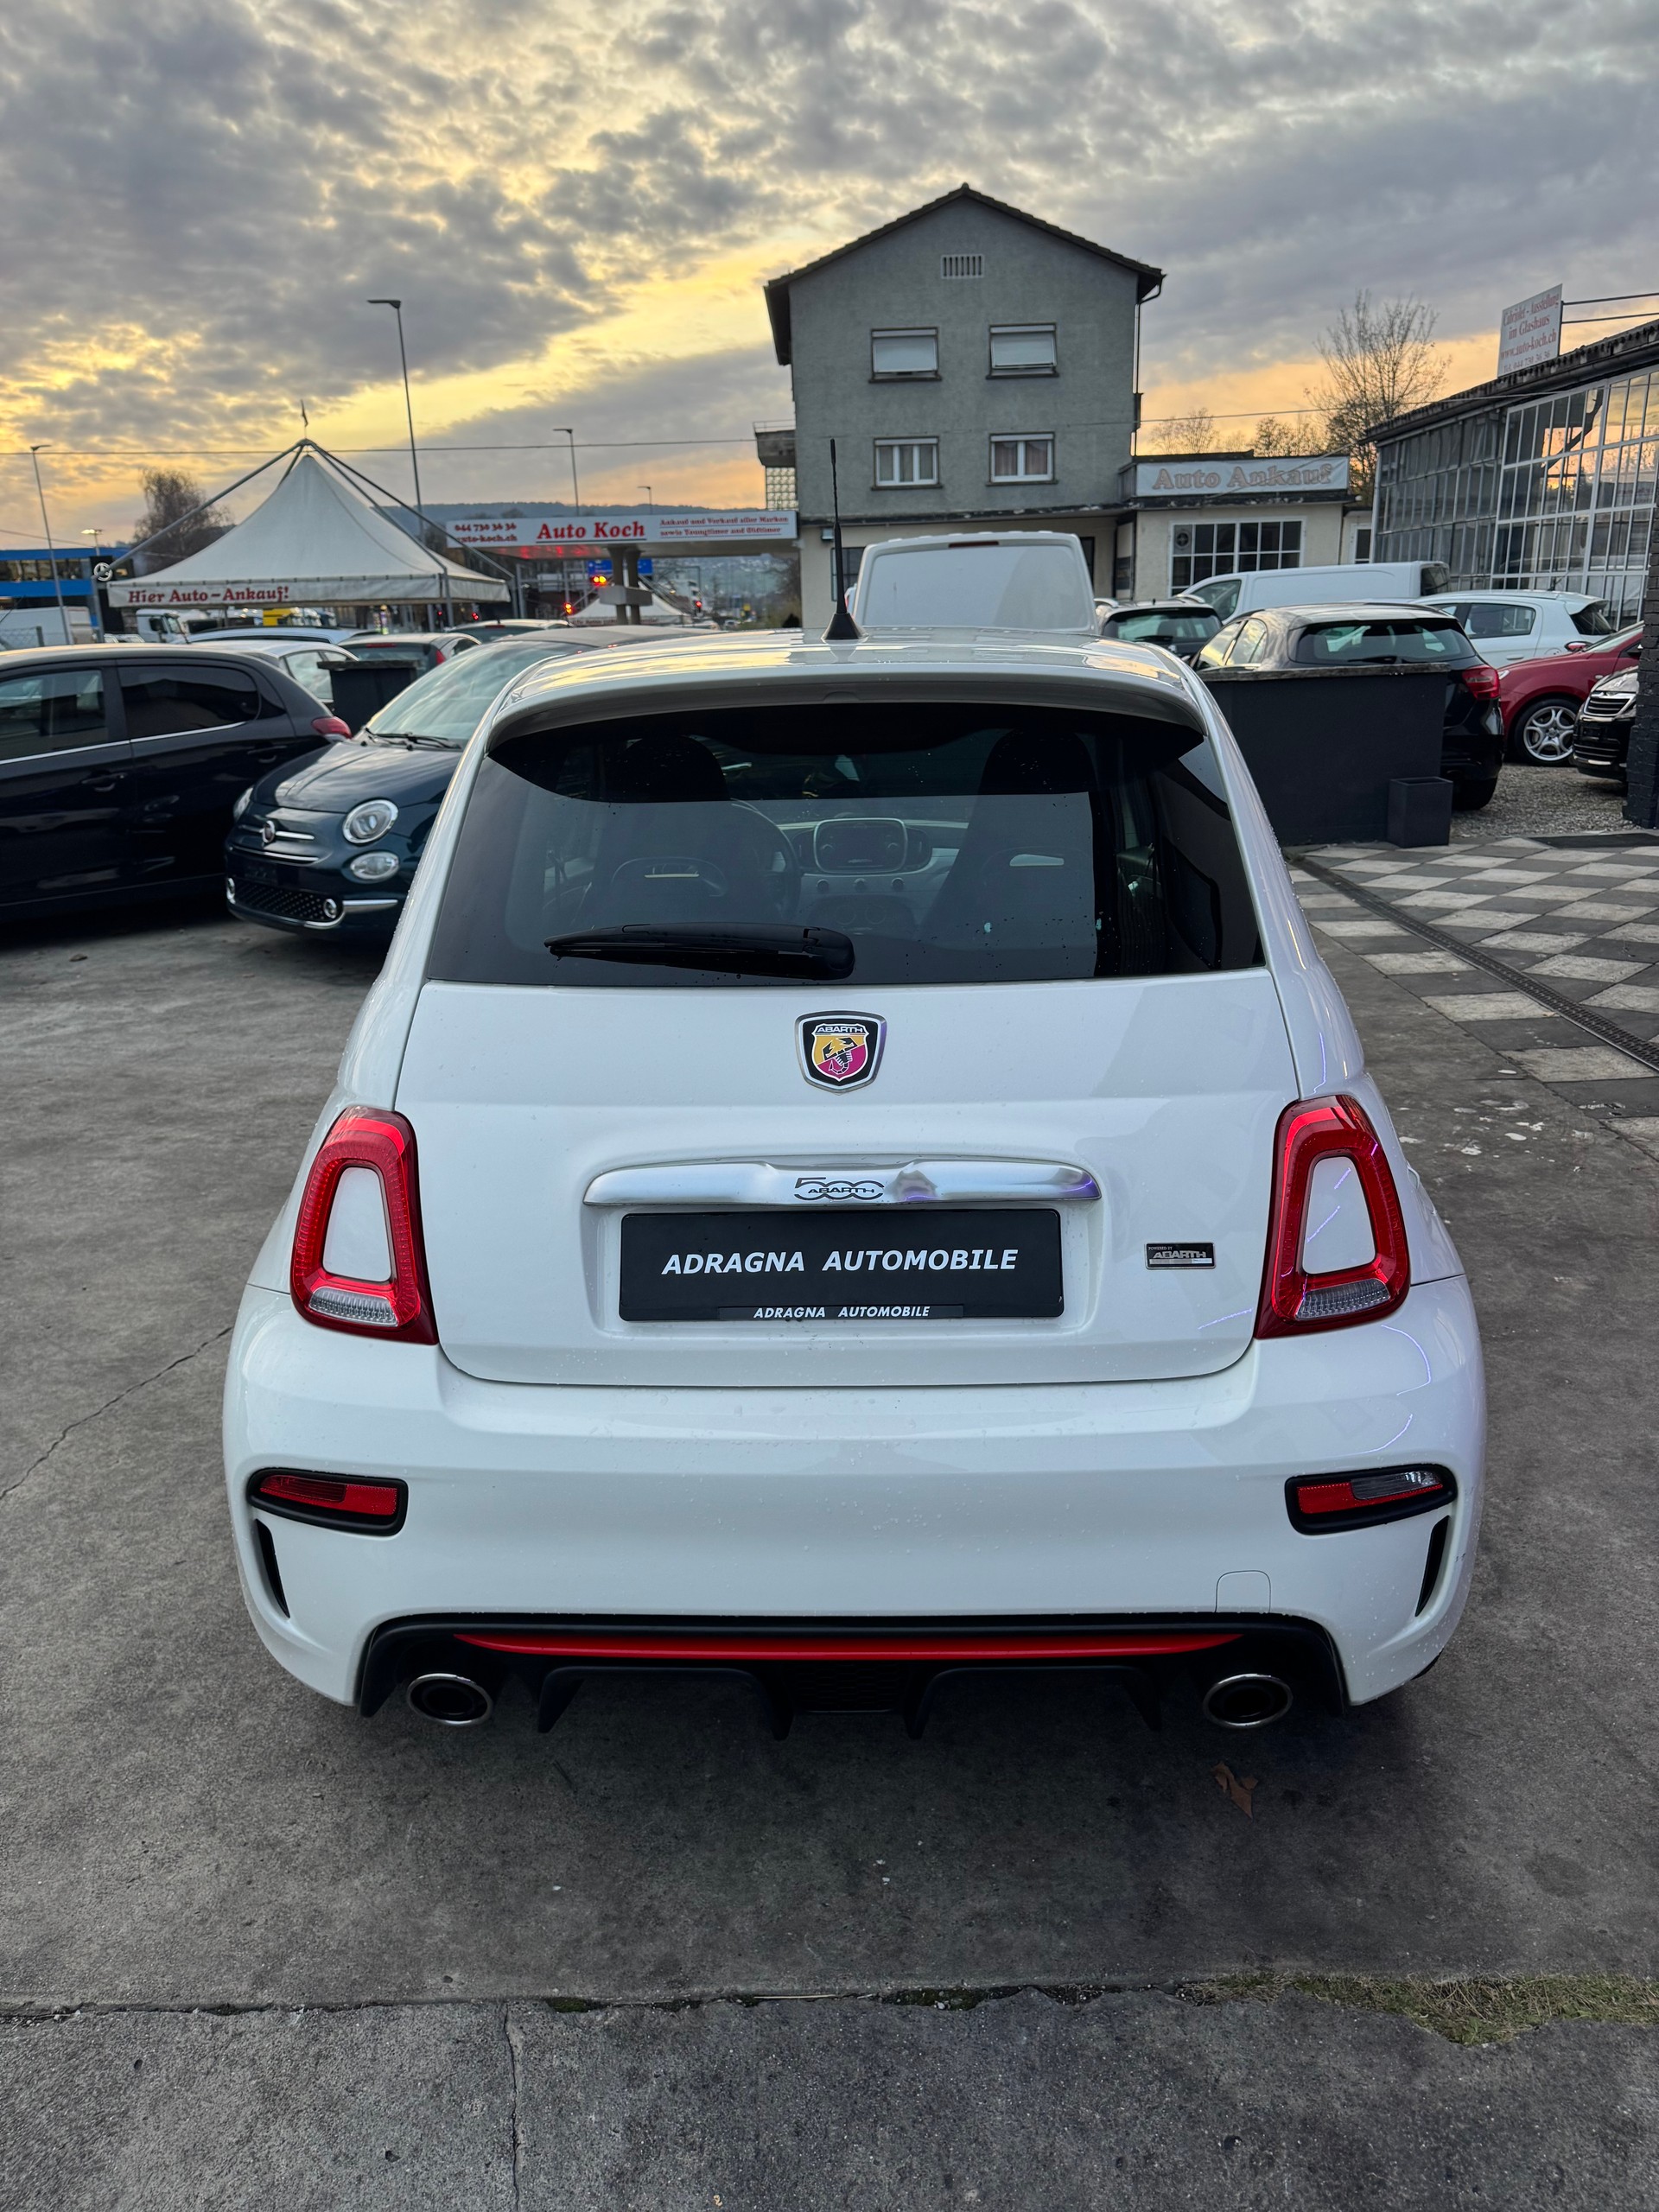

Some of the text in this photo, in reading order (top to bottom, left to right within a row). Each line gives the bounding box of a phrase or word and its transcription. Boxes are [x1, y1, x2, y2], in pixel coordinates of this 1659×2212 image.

[1508, 315, 1550, 340] im Glashaus
[1152, 463, 1334, 489] Auto Ankauf
[537, 520, 645, 539] Auto Koch
[128, 590, 165, 603] Hier
[794, 1177, 885, 1200] 500
[661, 1249, 1019, 1274] ADRAGNA AUTOMOBILE
[1153, 1250, 1206, 1259] ABARTH
[753, 1306, 930, 1318] ADRAGNA AUTOMOBILE
